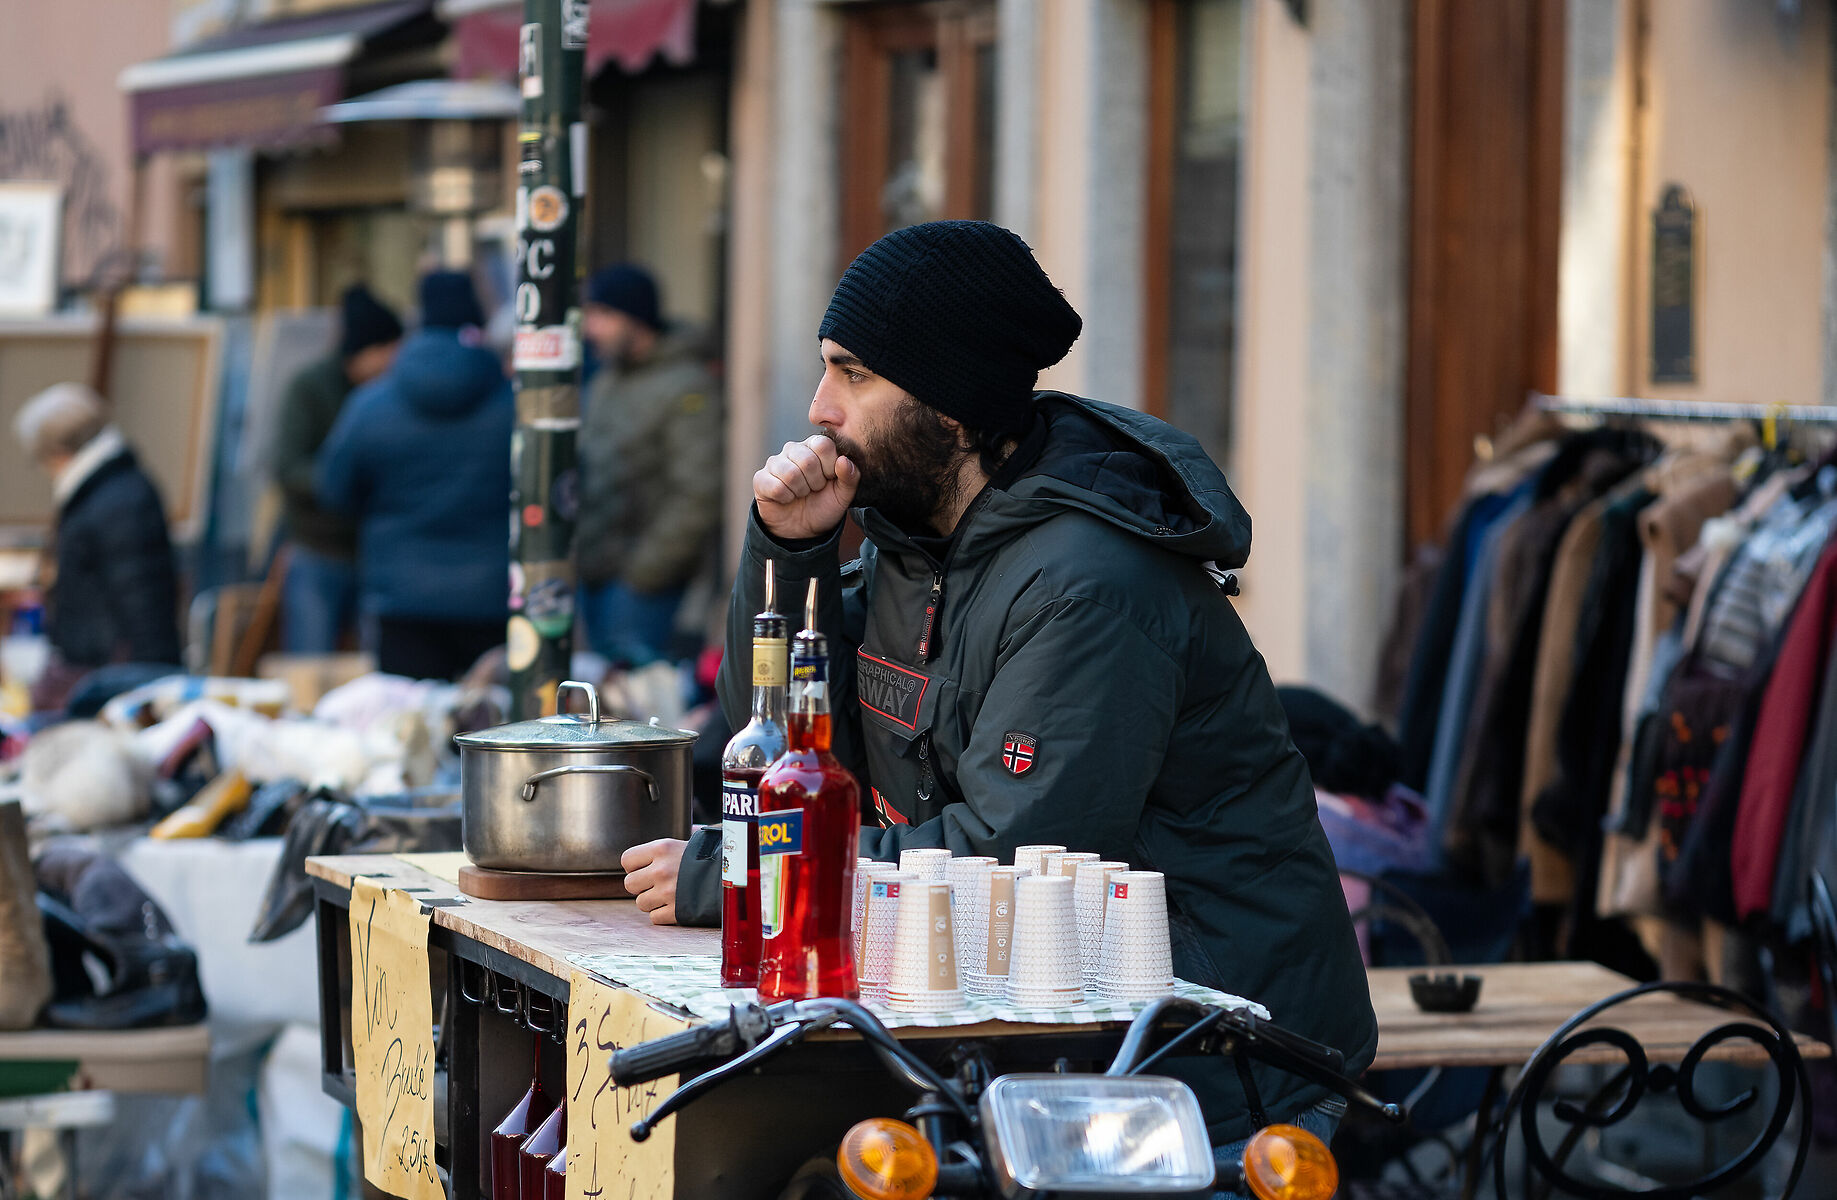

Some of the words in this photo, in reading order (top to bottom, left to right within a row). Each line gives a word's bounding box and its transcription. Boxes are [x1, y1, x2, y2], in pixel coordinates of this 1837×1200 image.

[759, 822, 792, 846] ROL
[357, 896, 398, 1042] Vin
[572, 1017, 590, 1103] 3
